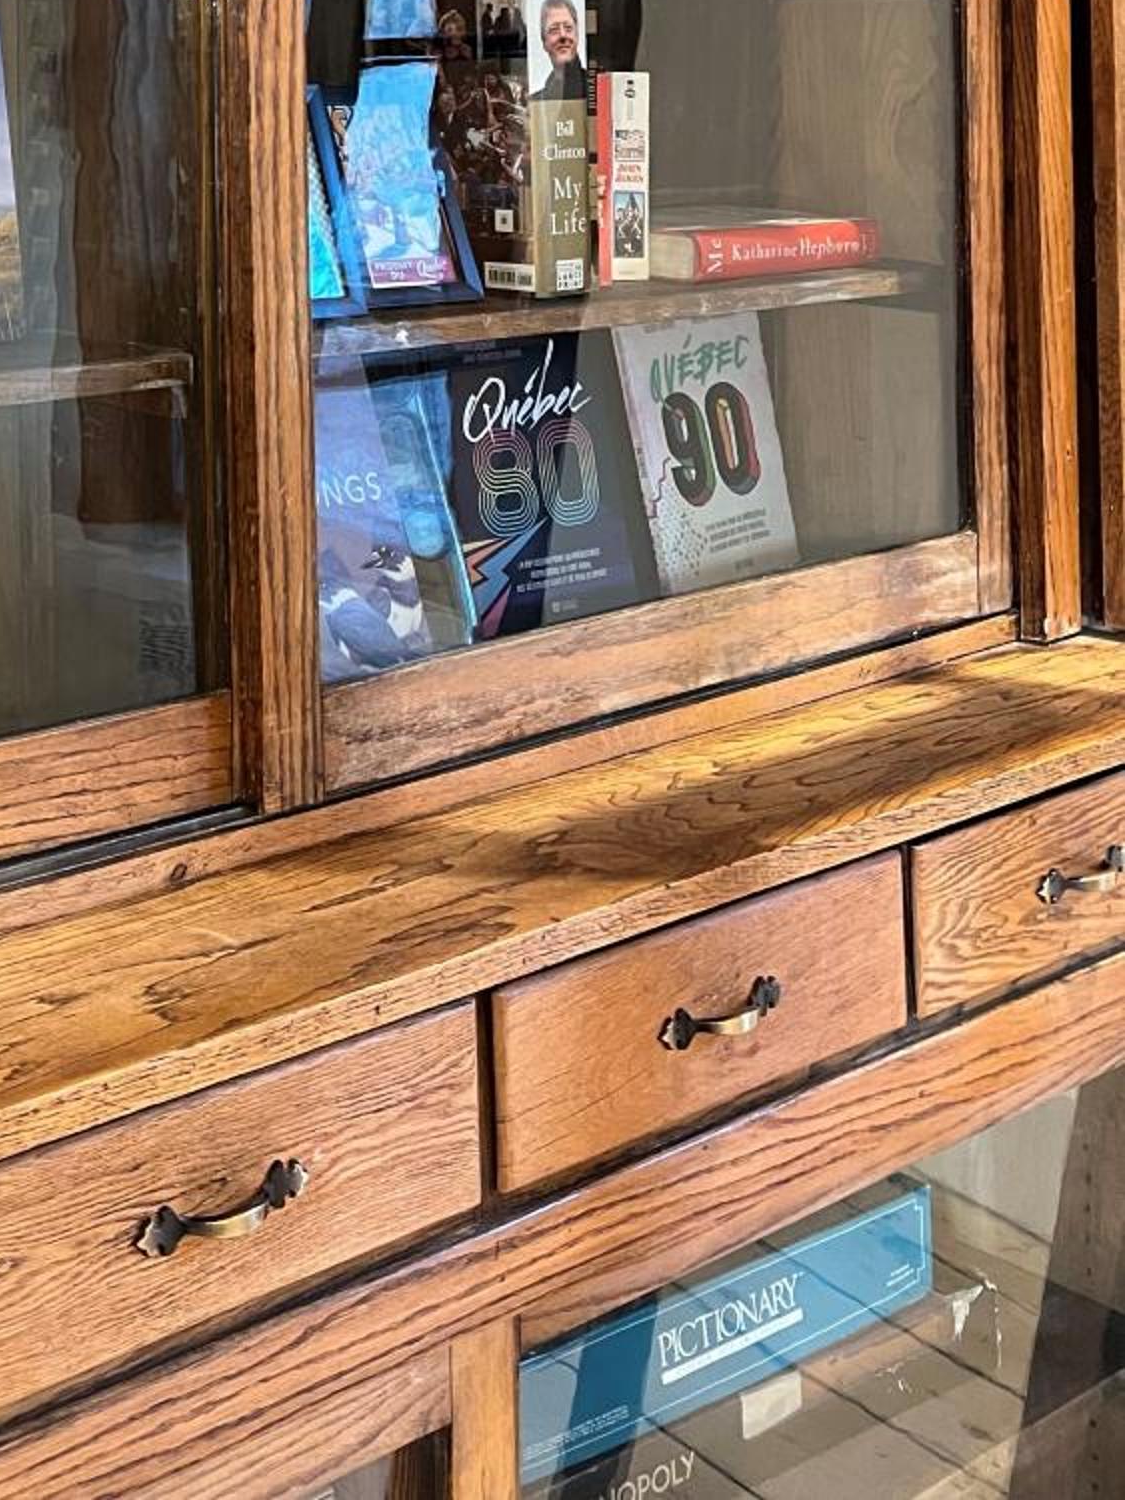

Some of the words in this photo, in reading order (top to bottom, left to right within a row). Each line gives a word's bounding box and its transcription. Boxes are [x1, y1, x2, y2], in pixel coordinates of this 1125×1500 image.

[556, 120, 574, 137] Bill
[543, 143, 586, 161] Clinton
[554, 177, 583, 203] My
[551, 206, 587, 235] Life
[731, 243, 796, 261] Katharine
[799, 236, 859, 261] Hepburn
[650, 334, 750, 404] QUÉBEC
[463, 338, 591, 442] Québec
[661, 382, 762, 507] 90
[320, 471, 382, 508] NGS
[473, 418, 601, 537] 80
[657, 1273, 798, 1367] PICTIONARY
